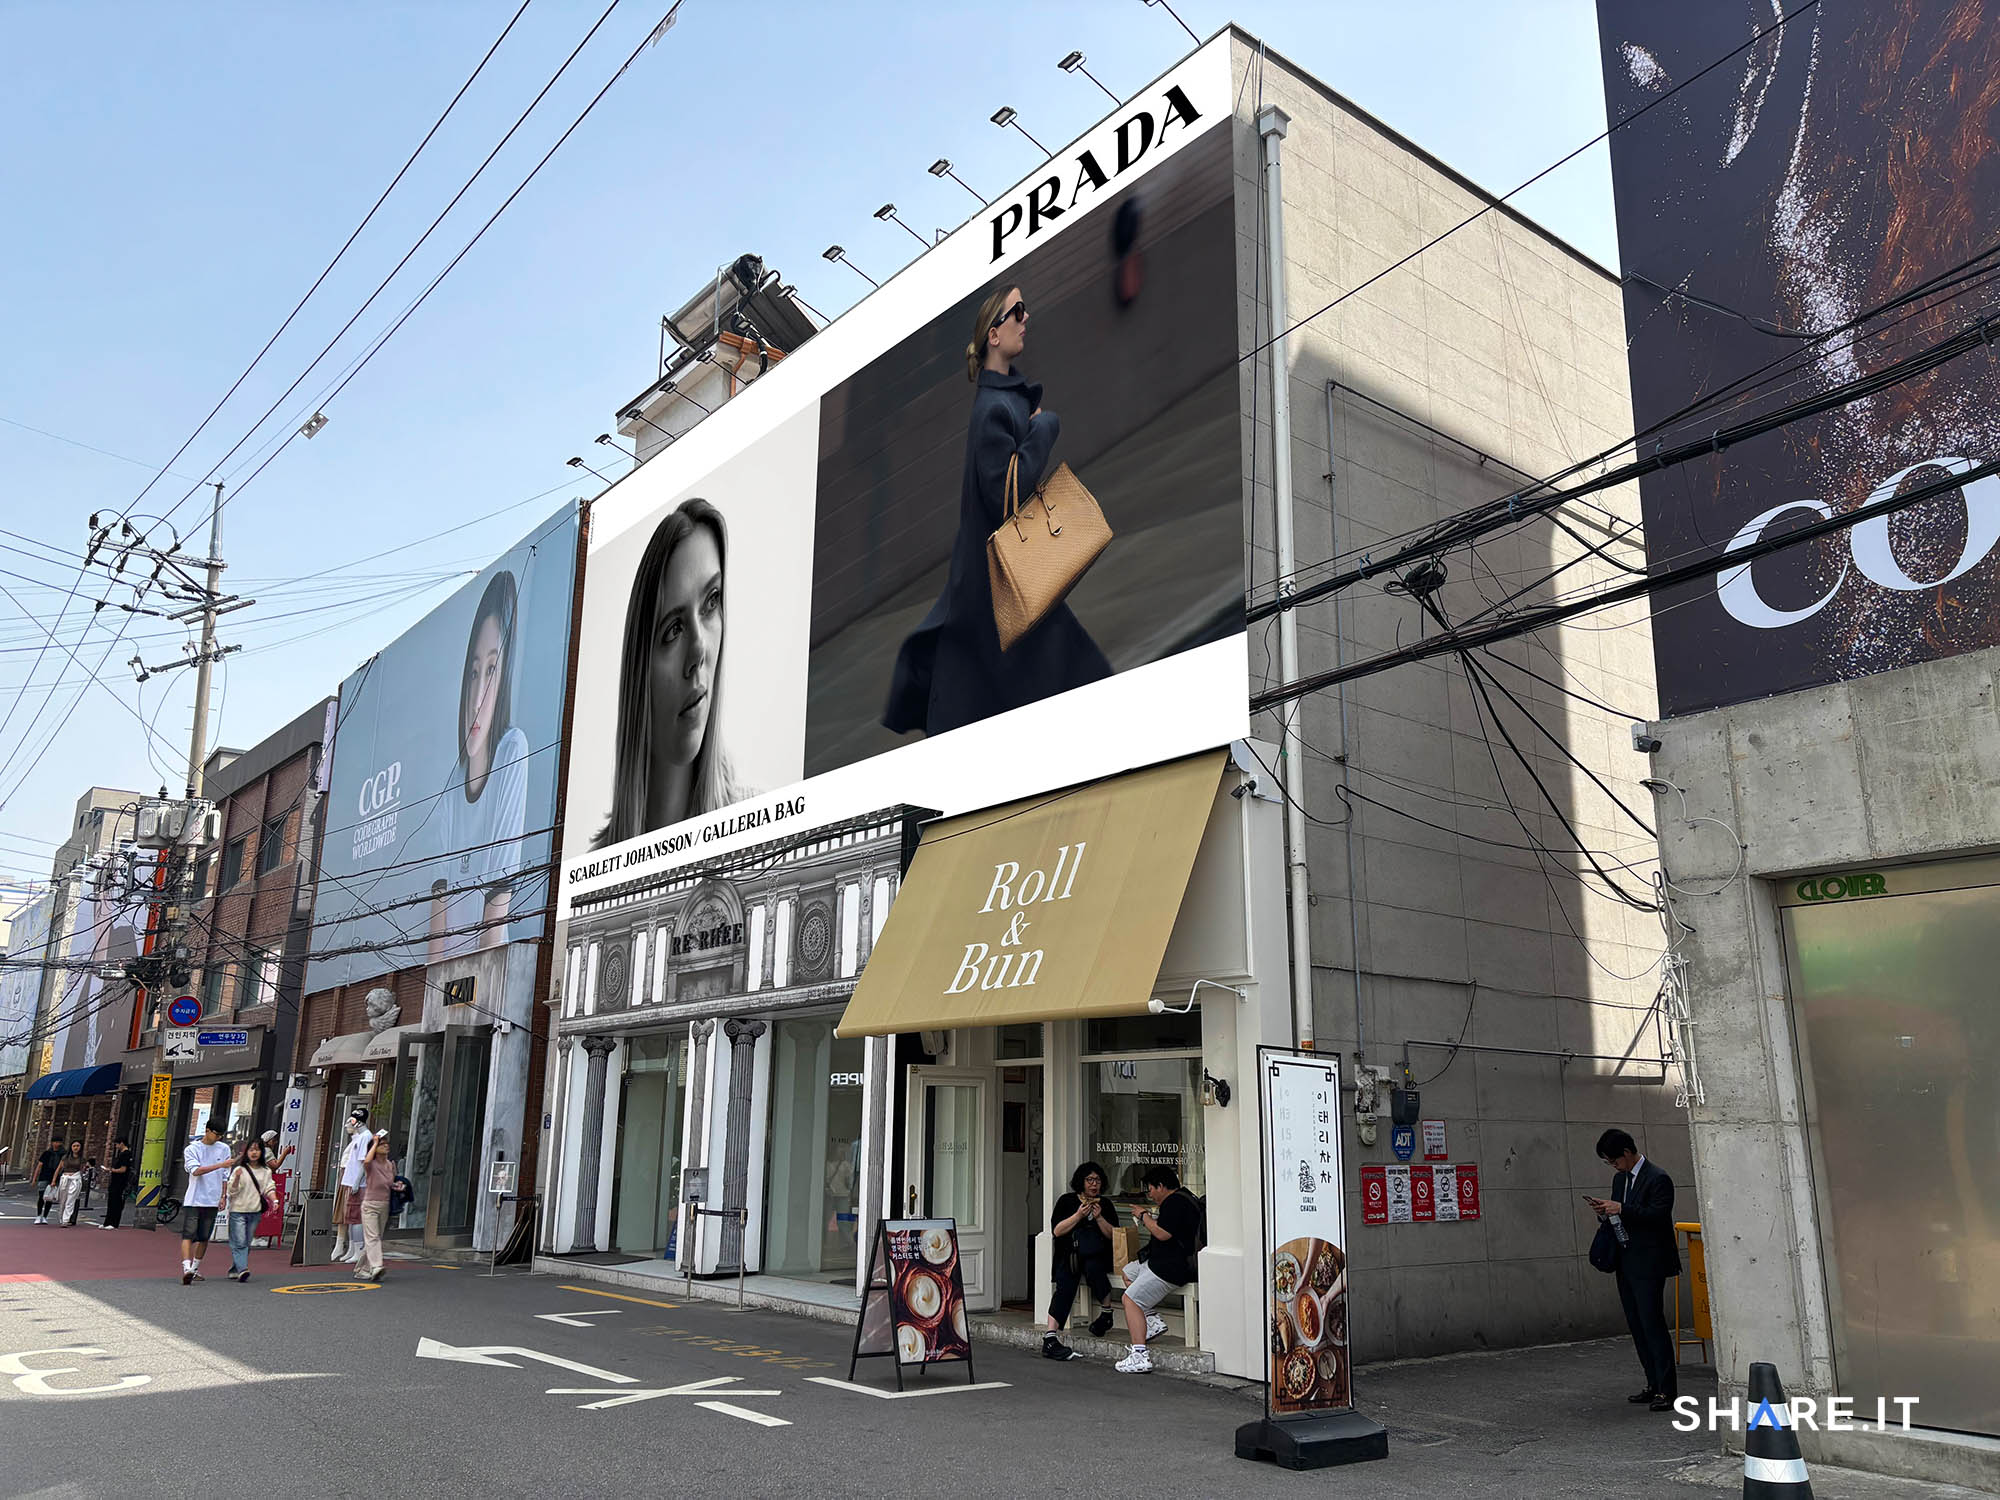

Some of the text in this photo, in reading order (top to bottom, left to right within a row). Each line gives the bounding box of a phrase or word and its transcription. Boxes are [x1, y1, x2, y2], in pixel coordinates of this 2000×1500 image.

[989, 84, 1203, 264] PRADA
[358, 761, 402, 816] CGP.
[352, 826, 397, 860] WORLDWIDE
[568, 796, 806, 885] SCARLETT JOHANSSON / GALLERIA BAG
[977, 842, 1087, 914] Roll
[1797, 873, 1888, 901] CLOVER
[1000, 911, 1031, 947] &
[943, 943, 1044, 995] Bun
[167, 1031, 196, 1040] 견인지역
[1096, 1142, 1121, 1152] BAKED
[1123, 1142, 1150, 1154] FRESH,
[1152, 1143, 1178, 1153] LOVED
[1316, 1091, 1332, 1184] 이태리차차
[1395, 1132, 1412, 1147] ADT
[1150, 1157, 1175, 1165] BAKERY
[892, 1252, 913, 1260] 커스터드
